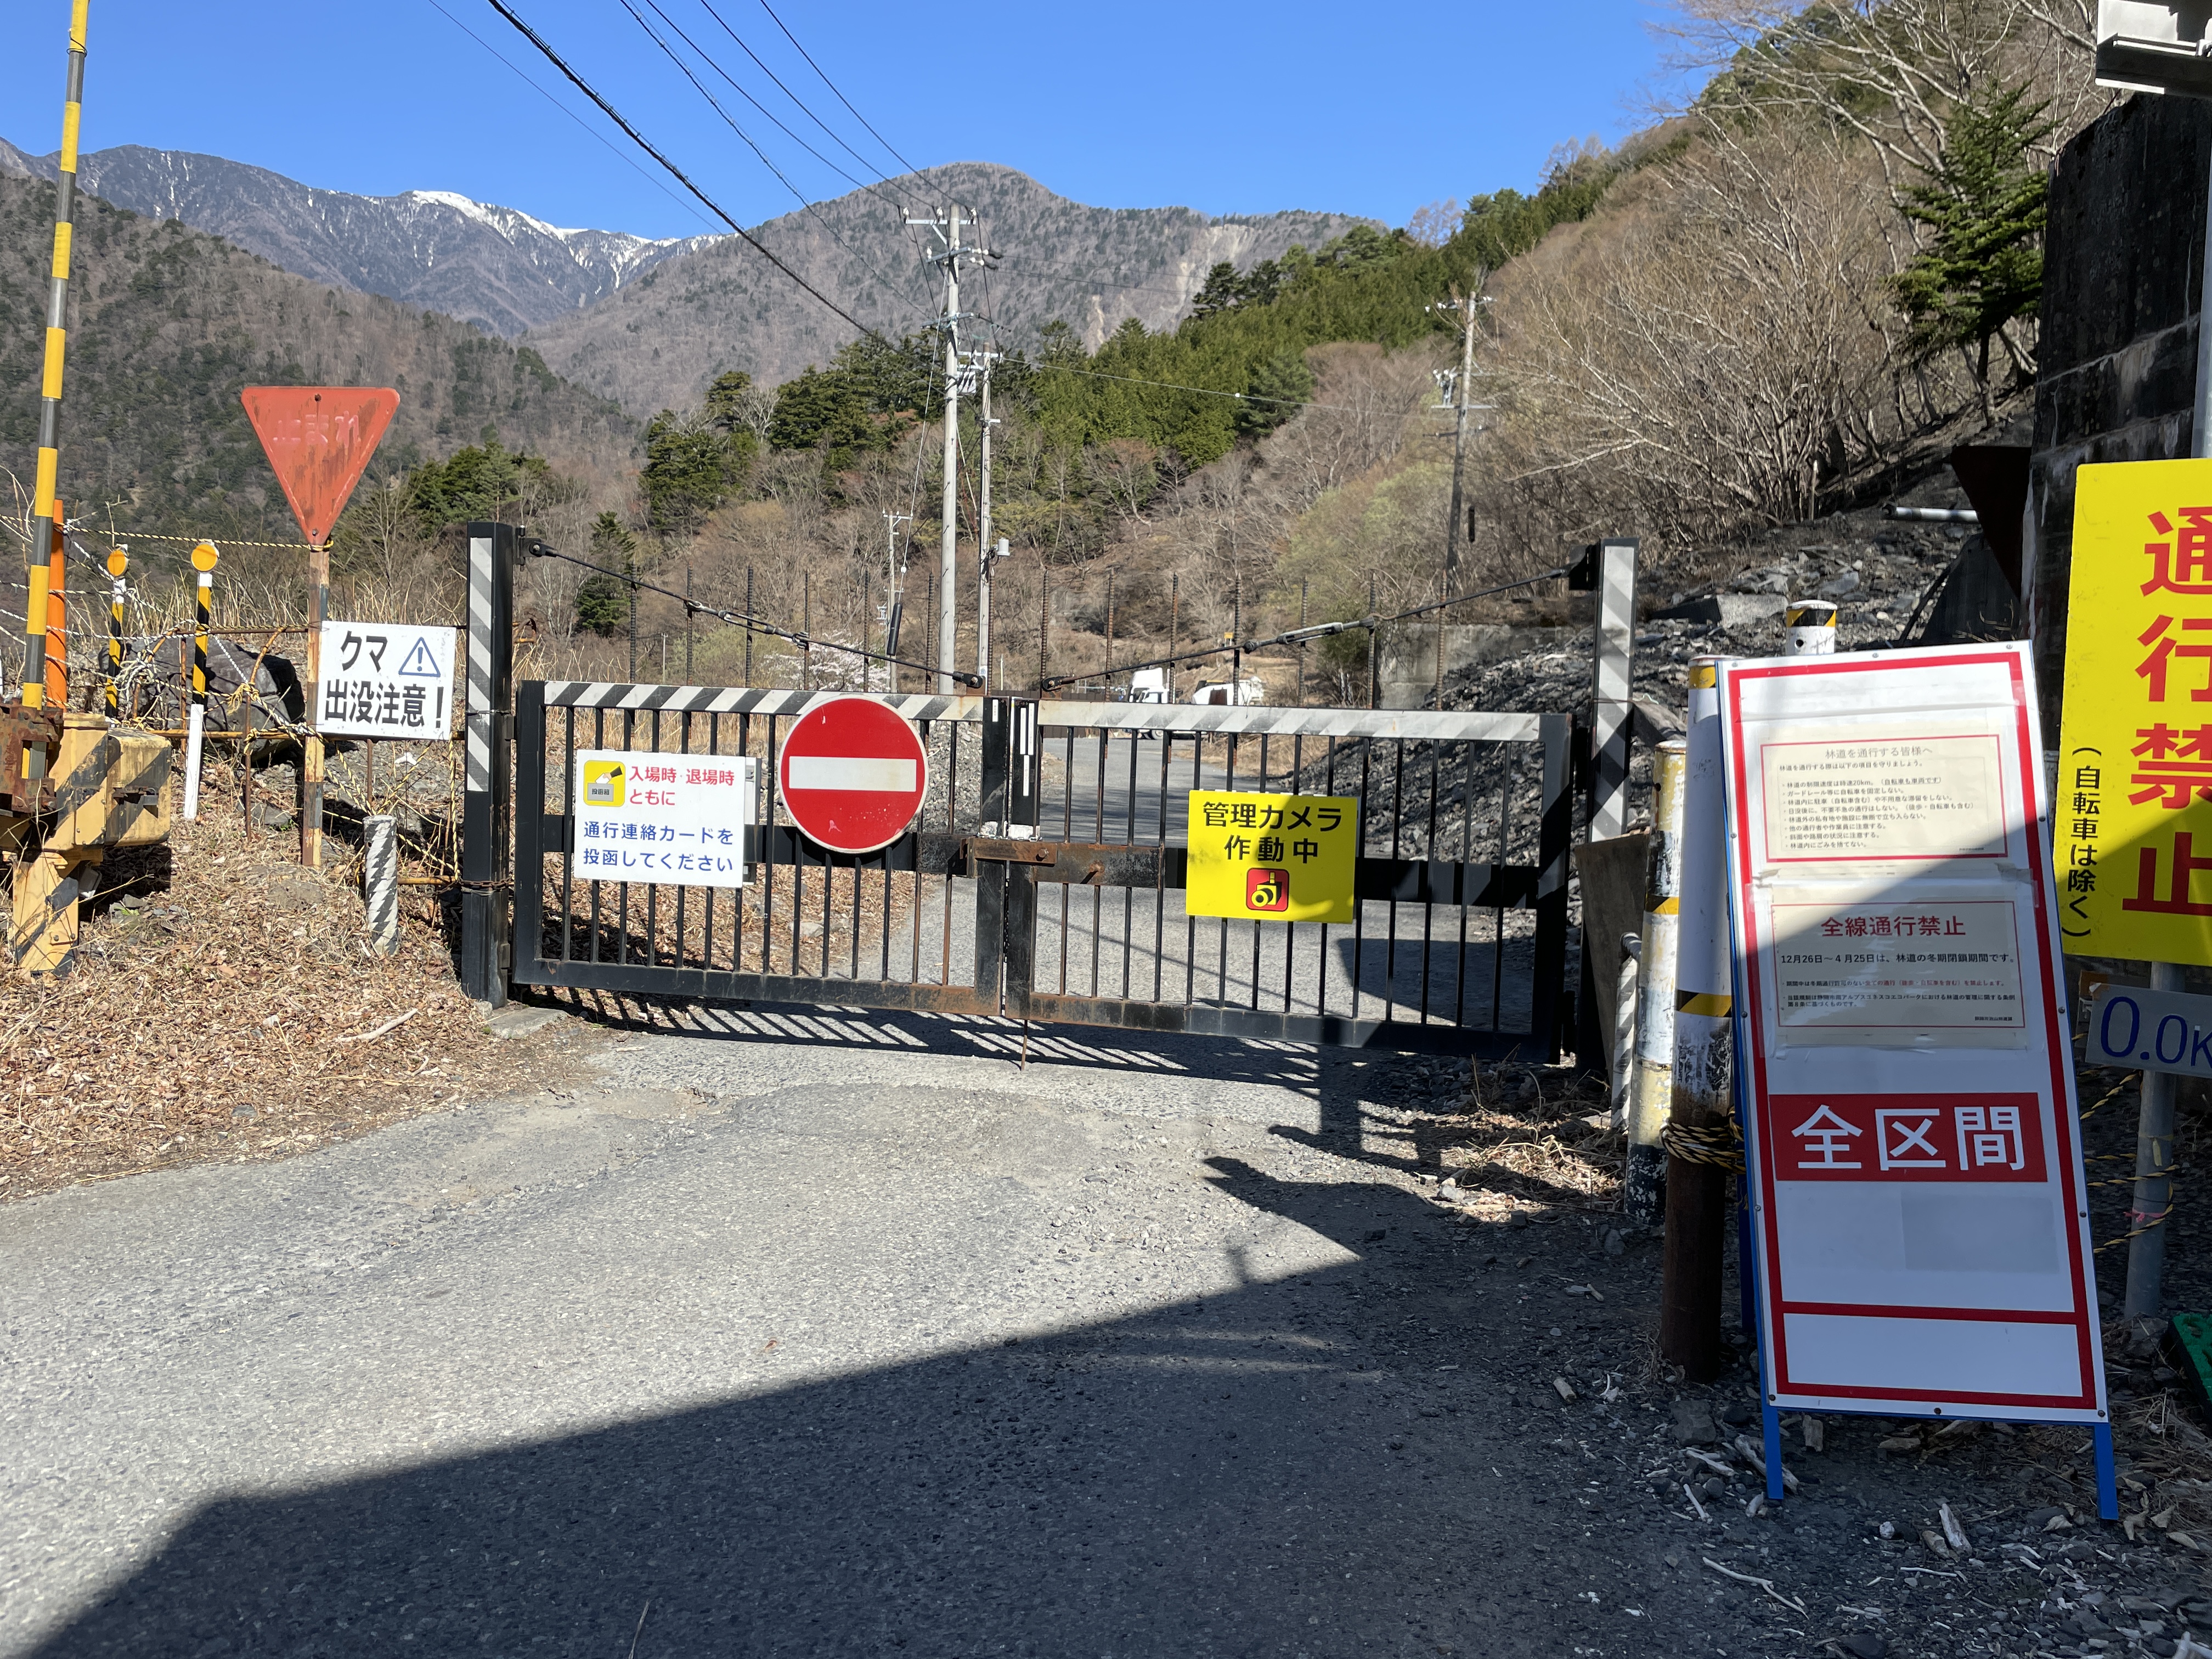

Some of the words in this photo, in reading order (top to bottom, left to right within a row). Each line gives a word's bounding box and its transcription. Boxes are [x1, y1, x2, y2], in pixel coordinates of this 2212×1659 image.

[340, 630, 388, 673] クマ
[325, 679, 444, 729] 出没注意！
[1825, 746, 1933, 760] 林道を通行する皆様へ
[630, 789, 675, 805] ともに
[1203, 802, 1342, 832] 管理カメラ
[584, 821, 733, 845] 通行連絡カードを
[2061, 747, 2102, 936] （自転車は除く）
[583, 848, 733, 872] 投函してください
[1224, 834, 1318, 864] 作動中
[1821, 916, 1966, 938] 全線通行禁止
[1791, 1104, 2025, 1171] 全区間
